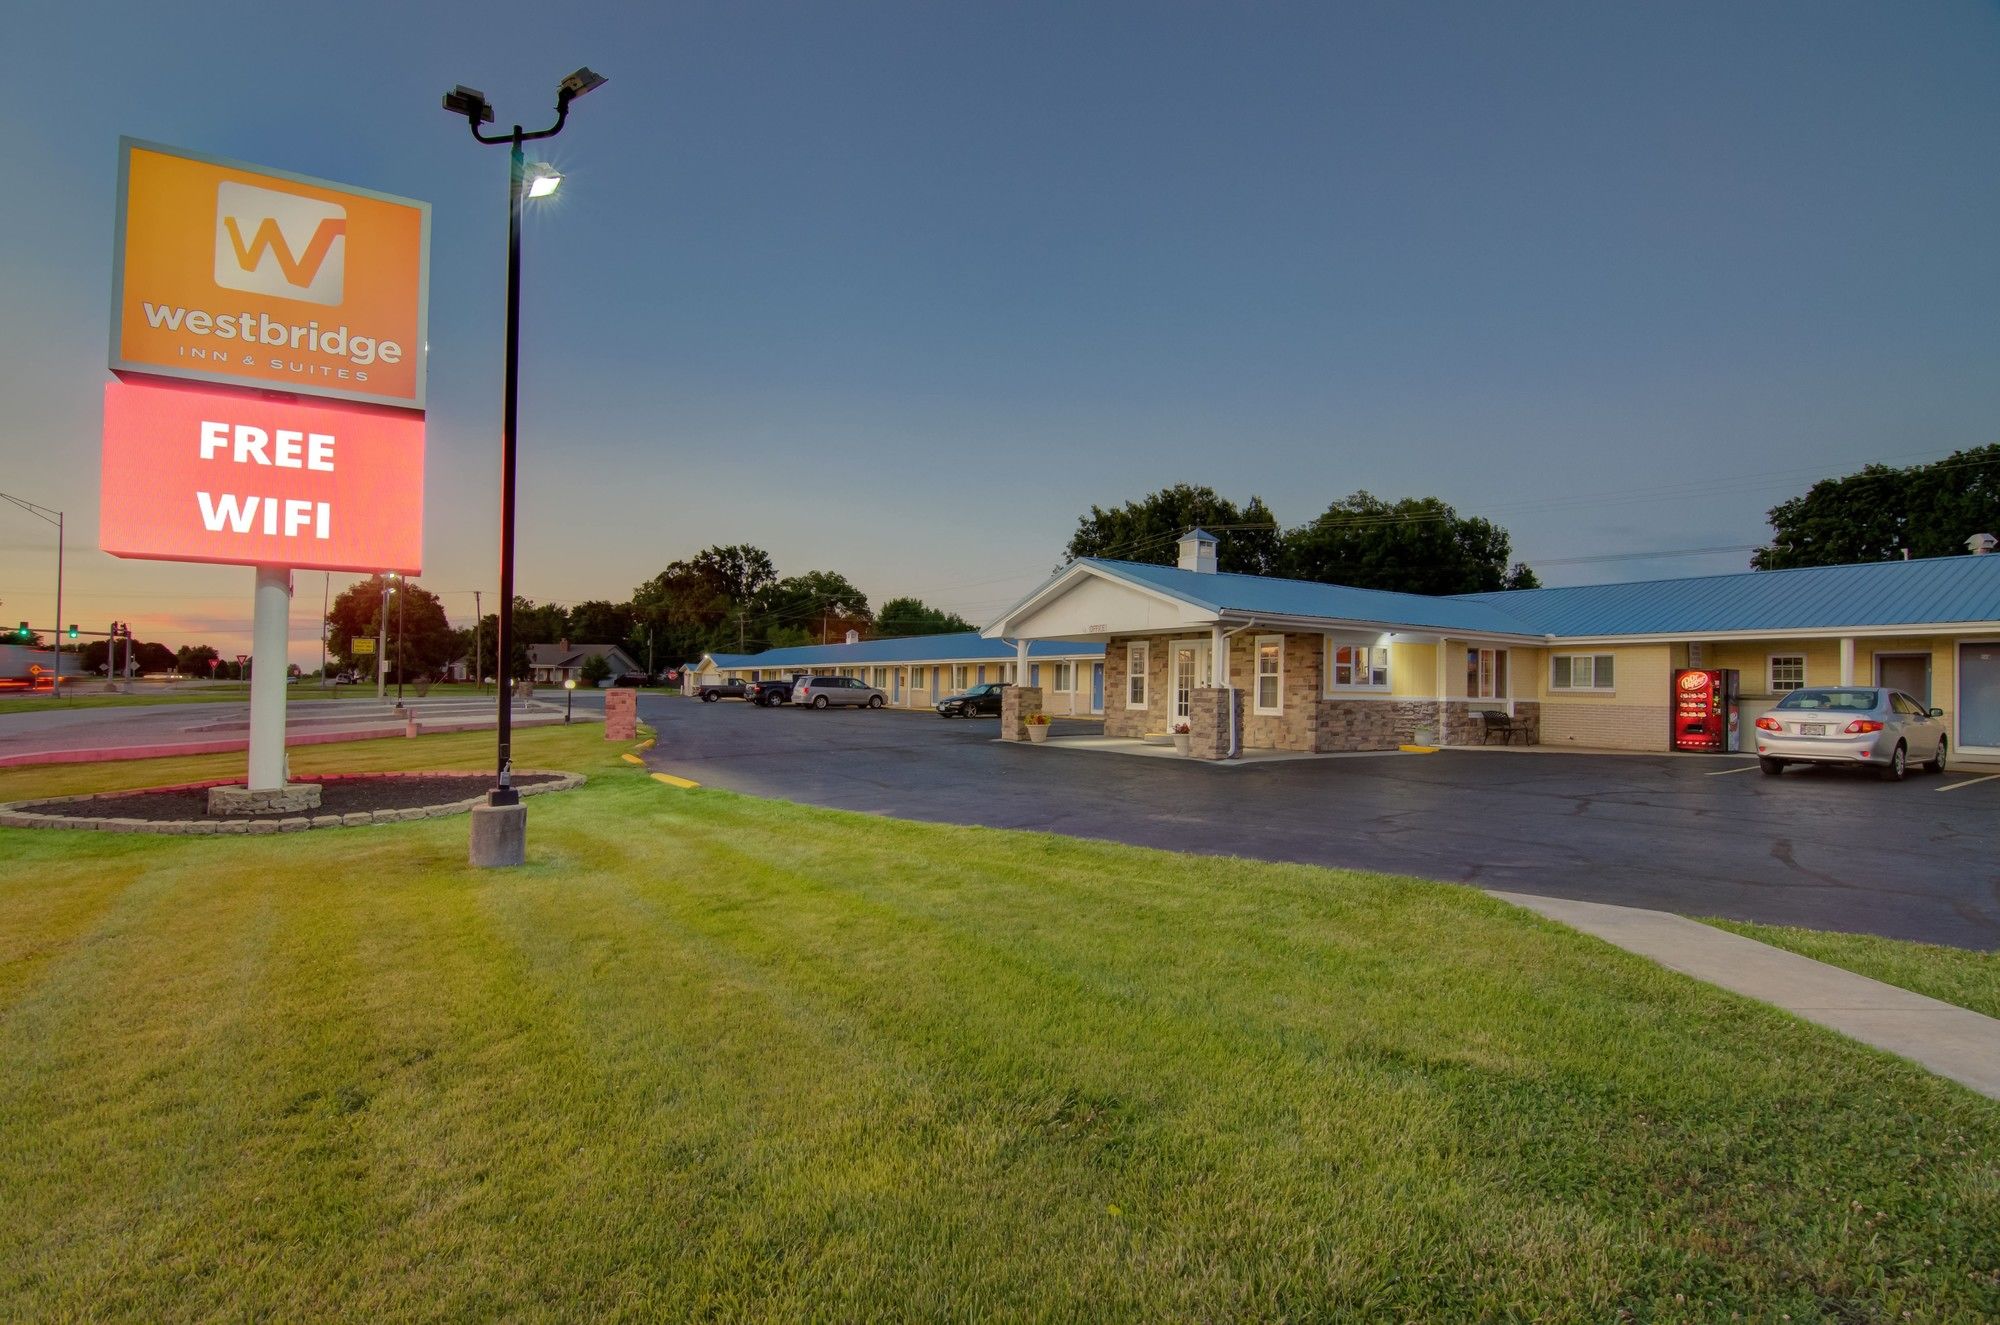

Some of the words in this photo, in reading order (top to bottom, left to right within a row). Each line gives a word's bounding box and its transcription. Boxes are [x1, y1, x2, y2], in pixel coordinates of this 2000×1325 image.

[142, 302, 402, 365] westbridge
[179, 346, 228, 362] INN
[242, 355, 256, 366] &
[270, 359, 369, 382] SUITES
[200, 420, 336, 472] FREE
[196, 491, 330, 539] WIFI
